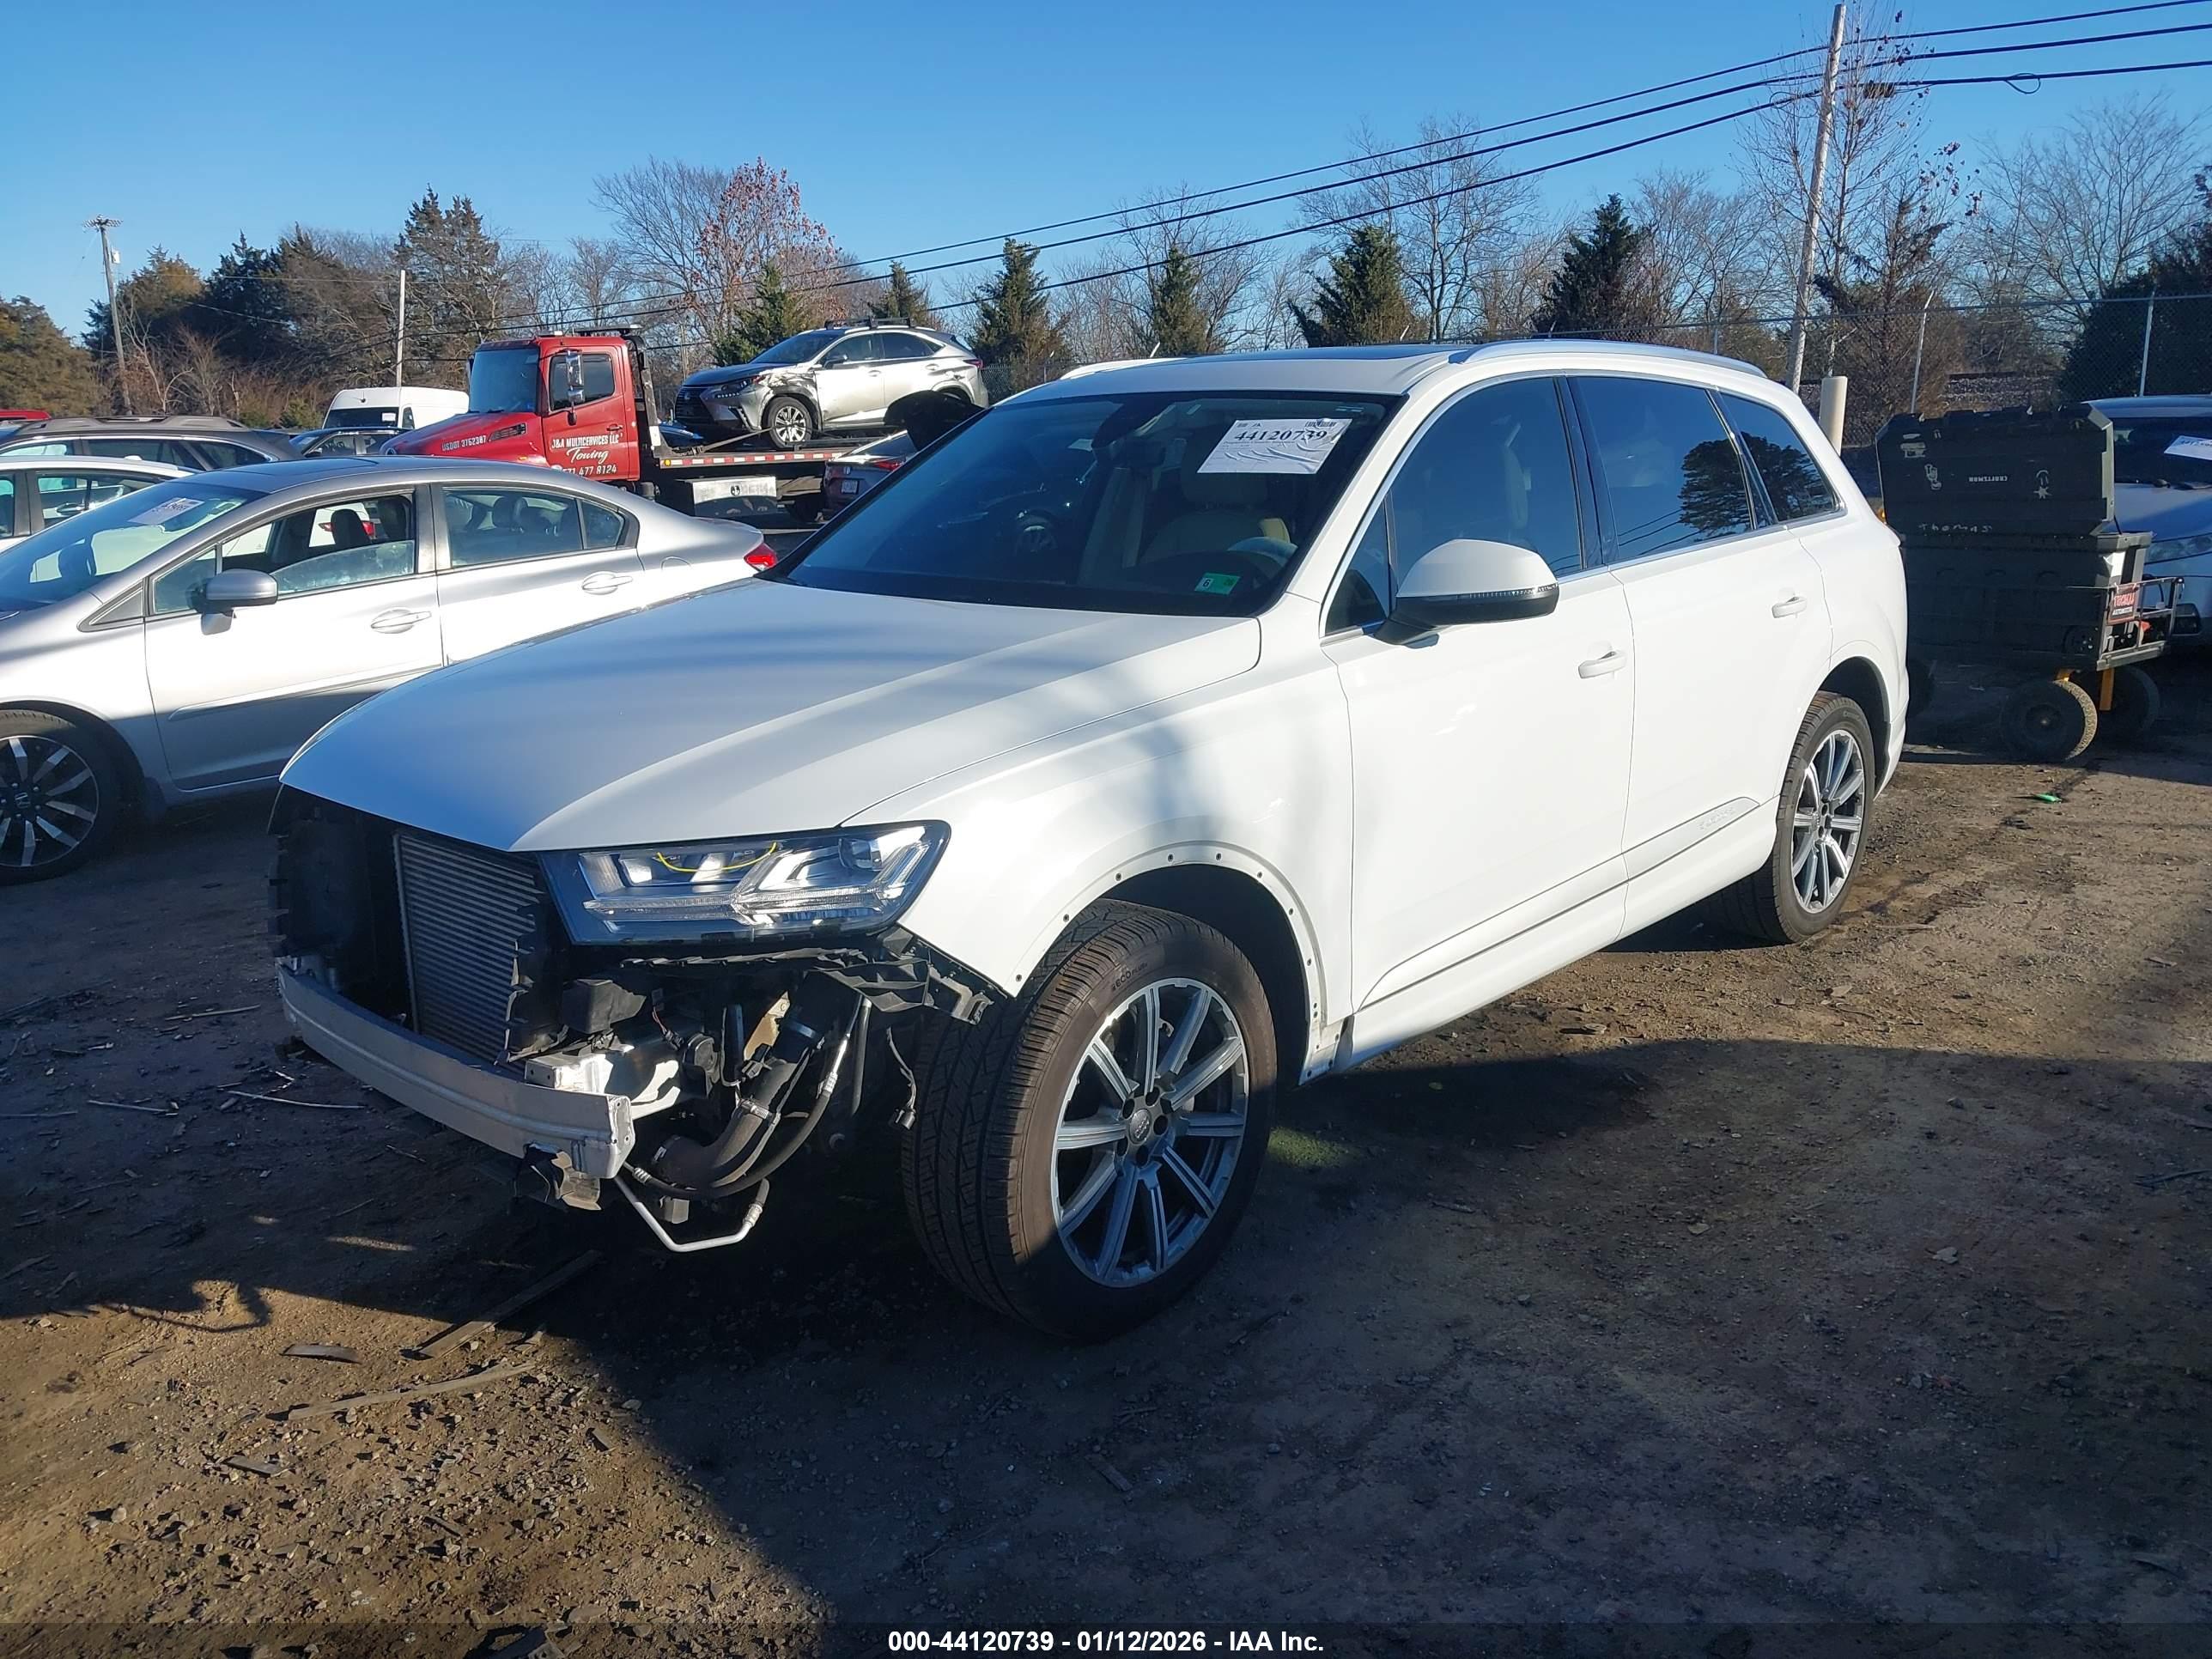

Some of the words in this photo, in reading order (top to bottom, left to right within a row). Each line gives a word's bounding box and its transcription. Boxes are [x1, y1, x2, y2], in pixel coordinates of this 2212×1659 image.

[551, 439, 564, 448] J&A
[610, 434, 619, 444] LLC
[1234, 430, 1328, 441] 44120739
[441, 441, 459, 452] USDOT
[566, 447, 609, 465] Towing
[579, 466, 594, 476] 477
[596, 465, 617, 474] 8124
